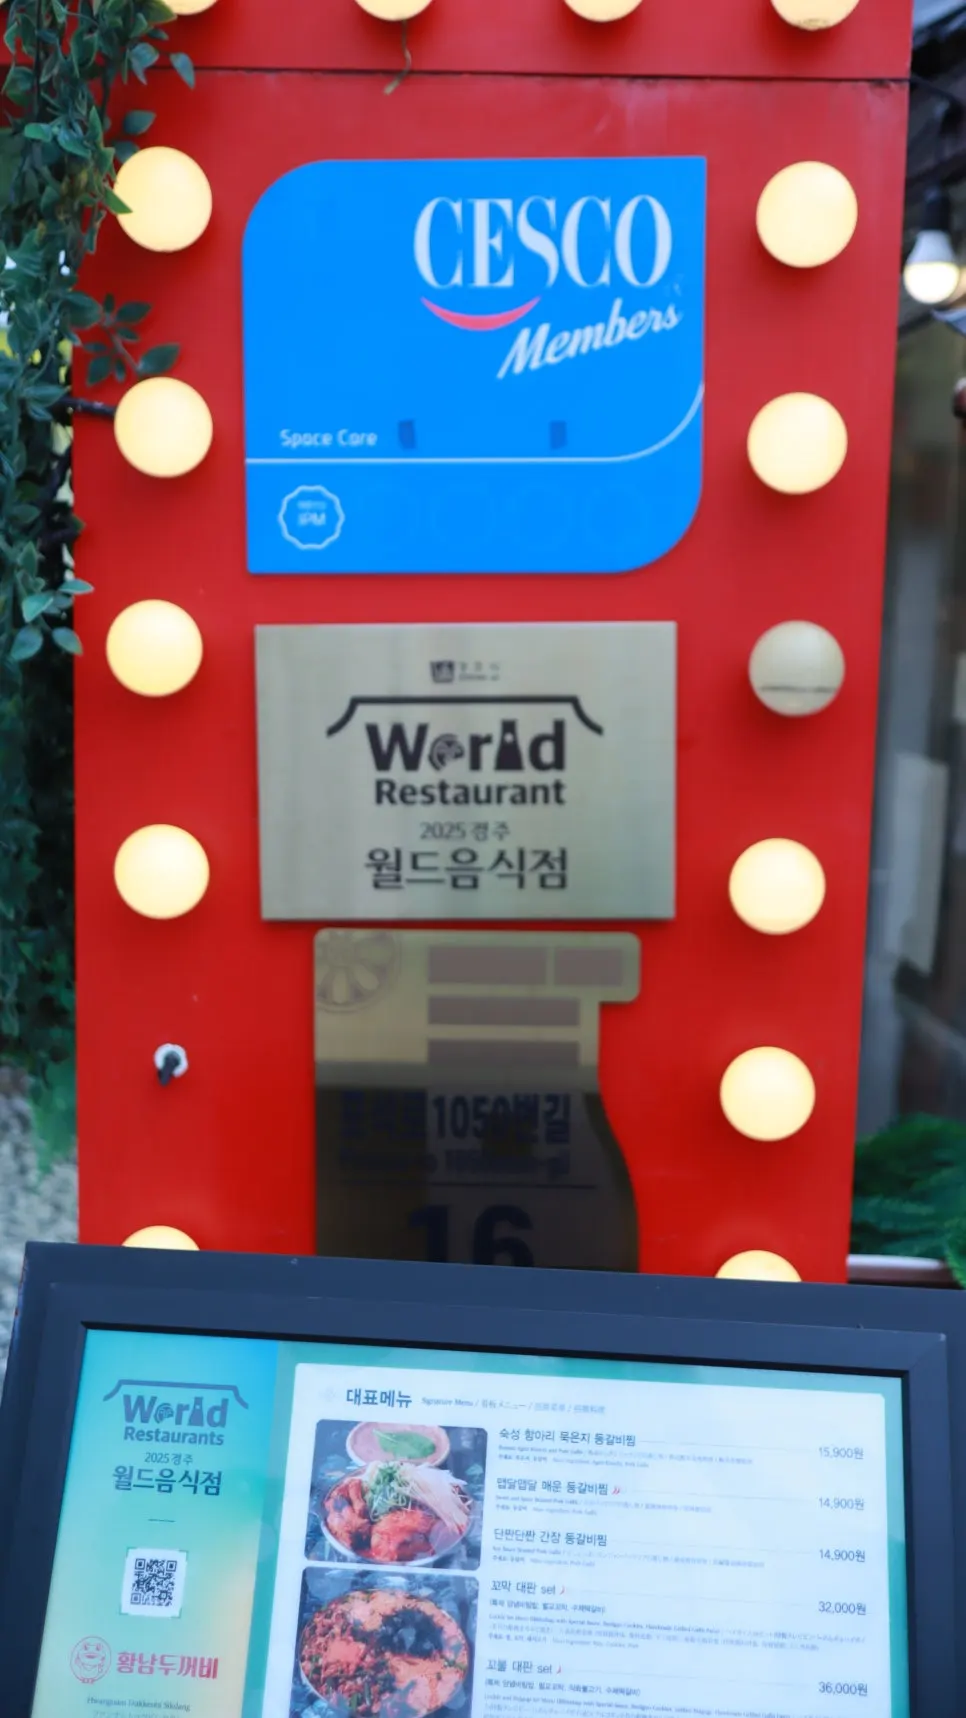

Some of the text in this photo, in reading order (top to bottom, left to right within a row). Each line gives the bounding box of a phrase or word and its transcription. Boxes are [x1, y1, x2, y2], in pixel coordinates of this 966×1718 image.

[414, 195, 672, 289] CESCO
[497, 297, 684, 380] Members
[280, 429, 377, 448] Space Care
[375, 778, 566, 806] Restaurant
[420, 821, 510, 842] 2025 경주
[364, 847, 568, 890] 월드음식점
[407, 1204, 535, 1267] 16
[346, 1388, 412, 1408] 대표메뉴
[124, 1426, 224, 1446] Restaurants
[499, 1428, 636, 1447] 숙성 항아리 묵은지 등갈비찜
[144, 1452, 193, 1466] 2025 경주
[818, 1446, 864, 1460] 15,900원
[112, 1465, 222, 1496] 월드음식점
[566, 1481, 608, 1496] 등갈비찜
[818, 1497, 865, 1511] 14,900원
[540, 1530, 561, 1544] 간장
[565, 1532, 607, 1547] 등갈비찜
[819, 1549, 866, 1563] 14,900원
[818, 1601, 867, 1616] 32,000원
[116, 1651, 219, 1680] 황남두꺼비
[537, 1663, 553, 1675] set
[818, 1681, 868, 1697] 36,000원
